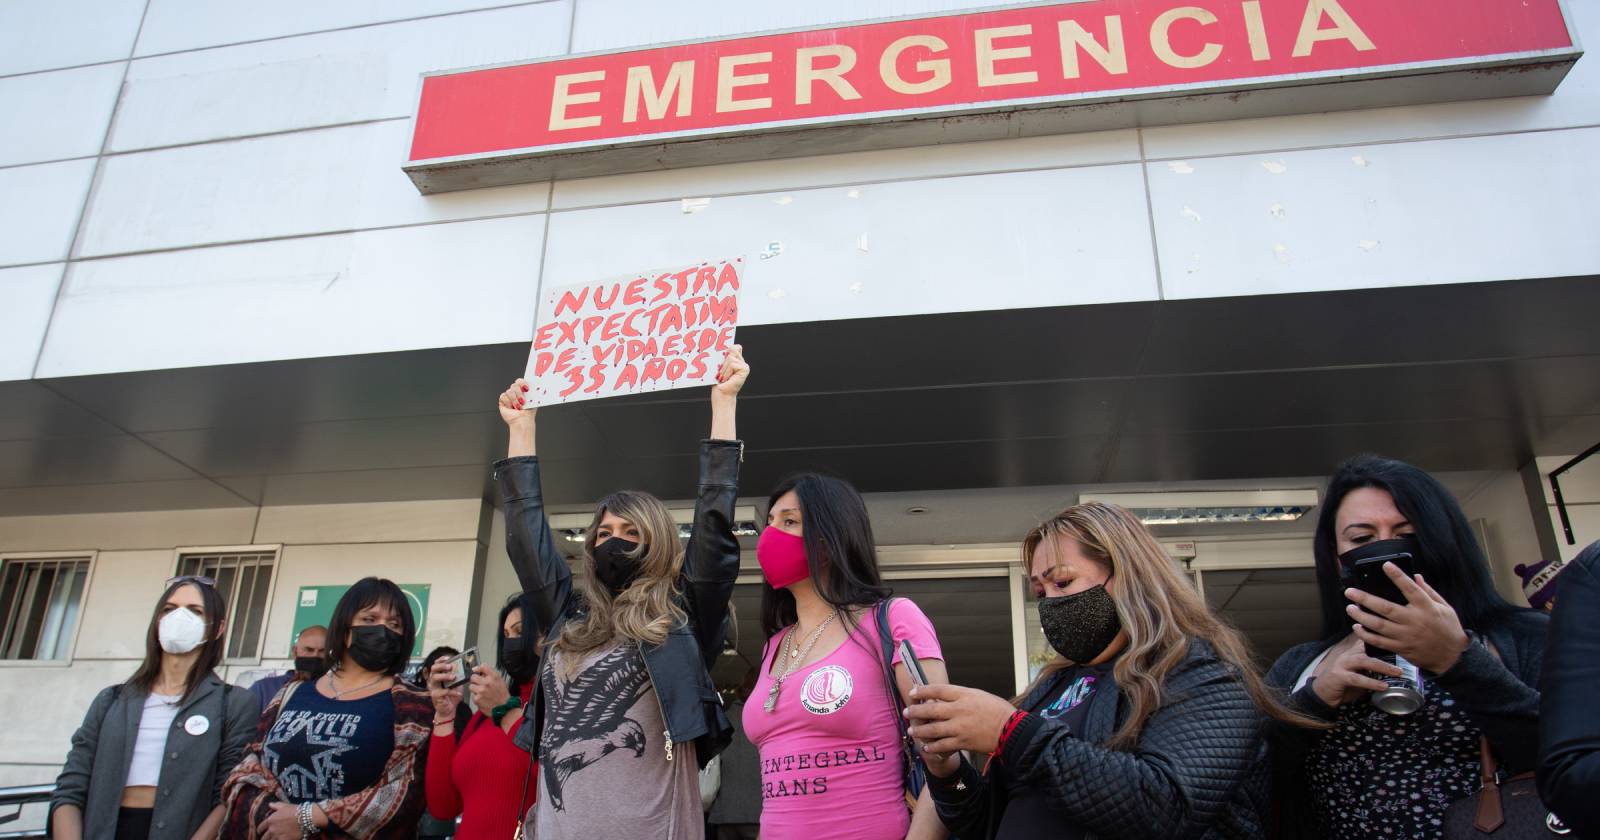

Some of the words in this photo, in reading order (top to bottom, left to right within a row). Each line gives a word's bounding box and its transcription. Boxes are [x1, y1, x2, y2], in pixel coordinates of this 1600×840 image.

[548, 0, 1376, 132] EMERGENCIA
[555, 263, 739, 318] NUESTRA
[534, 294, 738, 350] EXPECTATIVA
[535, 348, 578, 377] DE
[560, 363, 608, 397] 35
[764, 745, 886, 775] INTEGRAL
